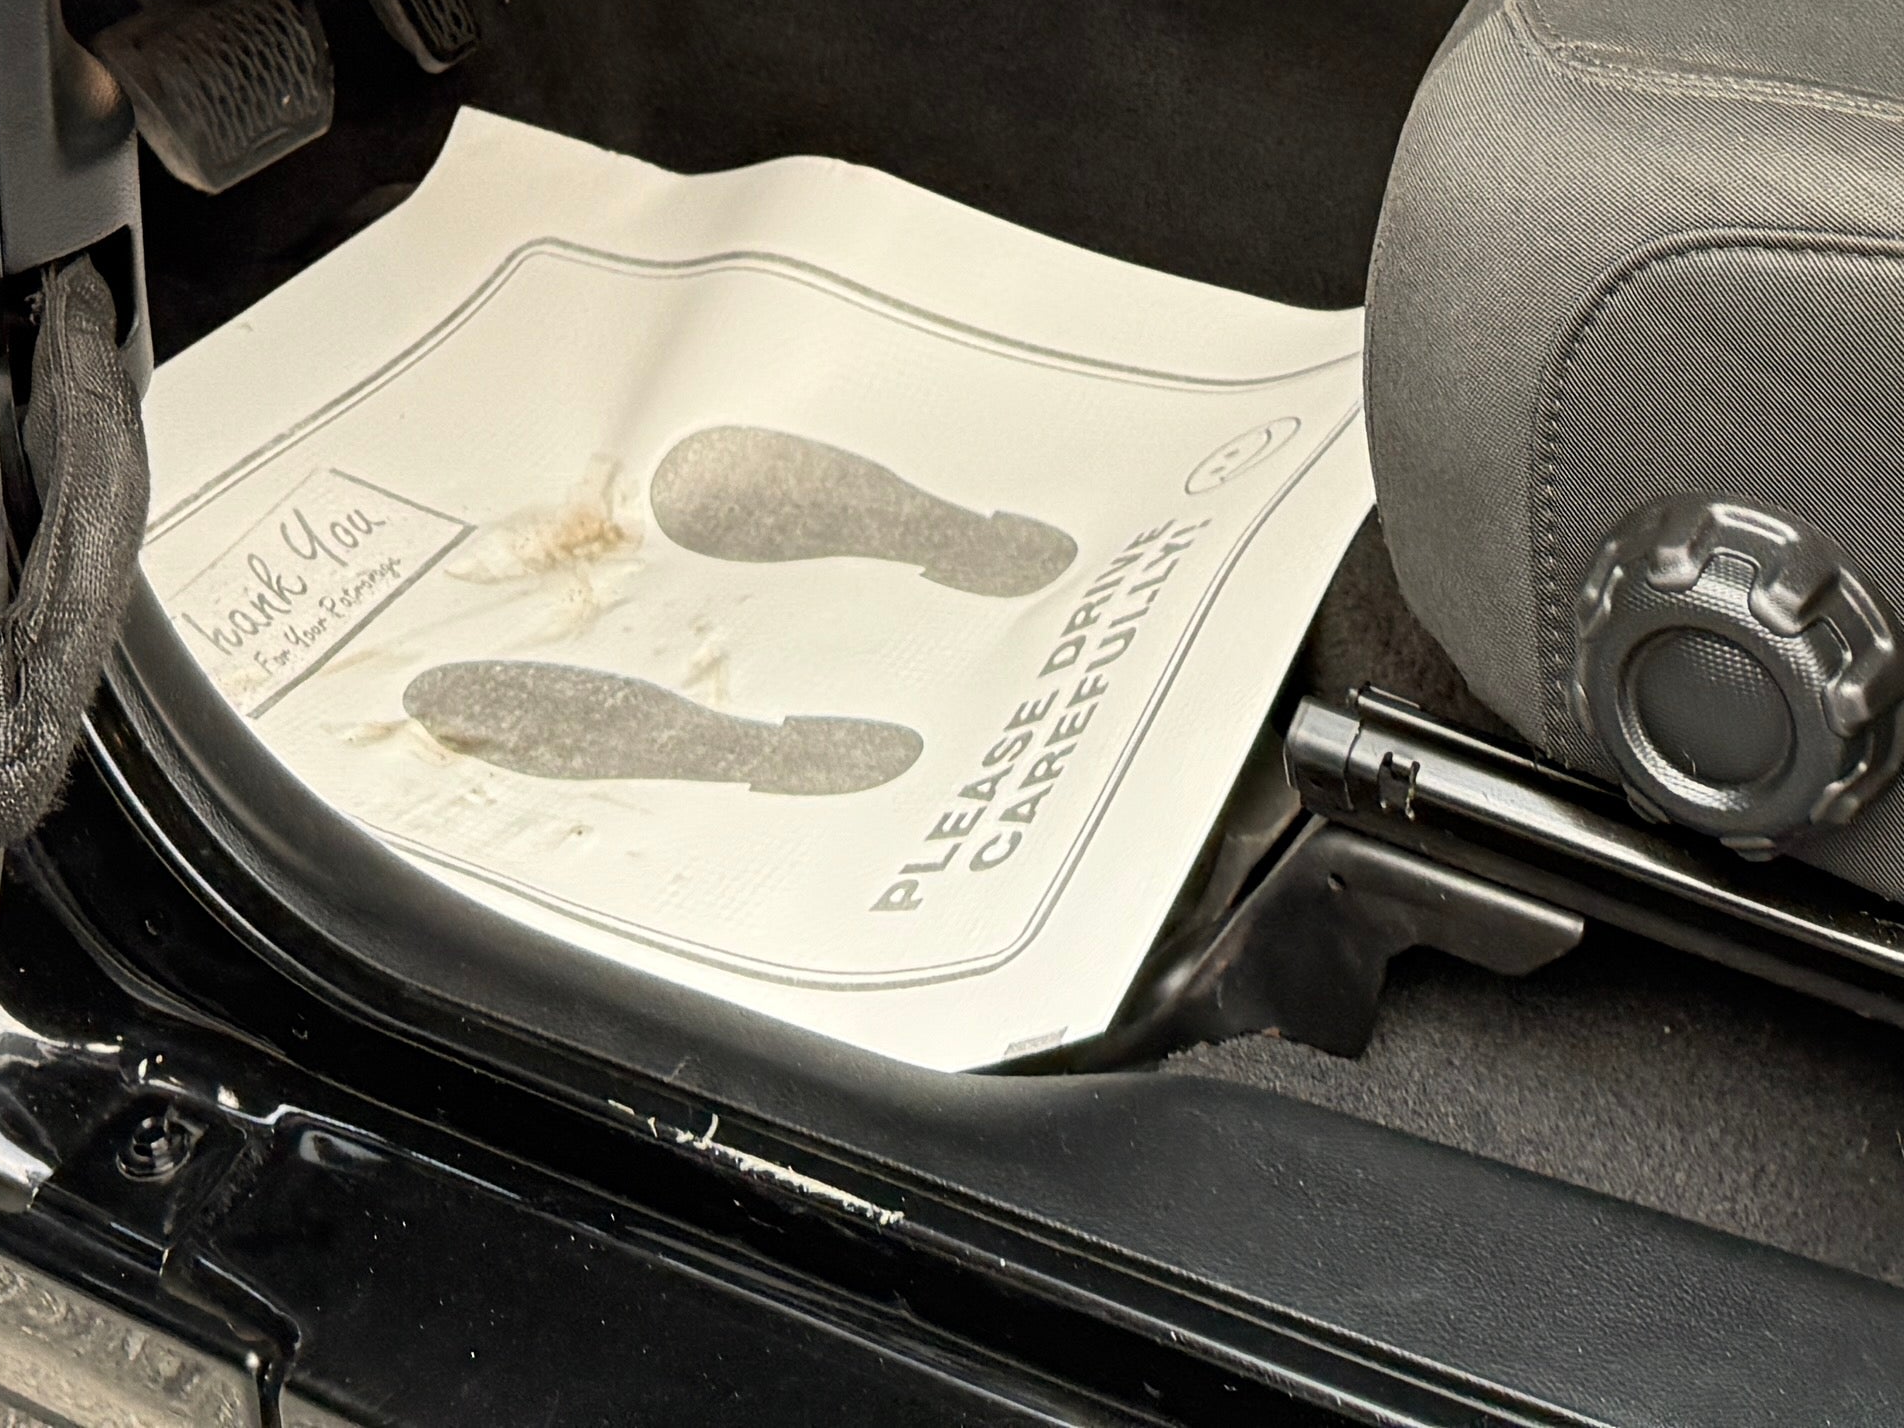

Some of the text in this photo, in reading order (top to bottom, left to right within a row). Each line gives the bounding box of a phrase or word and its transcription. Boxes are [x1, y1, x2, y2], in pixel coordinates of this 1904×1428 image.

[182, 508, 386, 656] hank You
[868, 519, 1177, 912] PLEASE DRIVE
[969, 518, 1212, 872] CAREFULLY!
